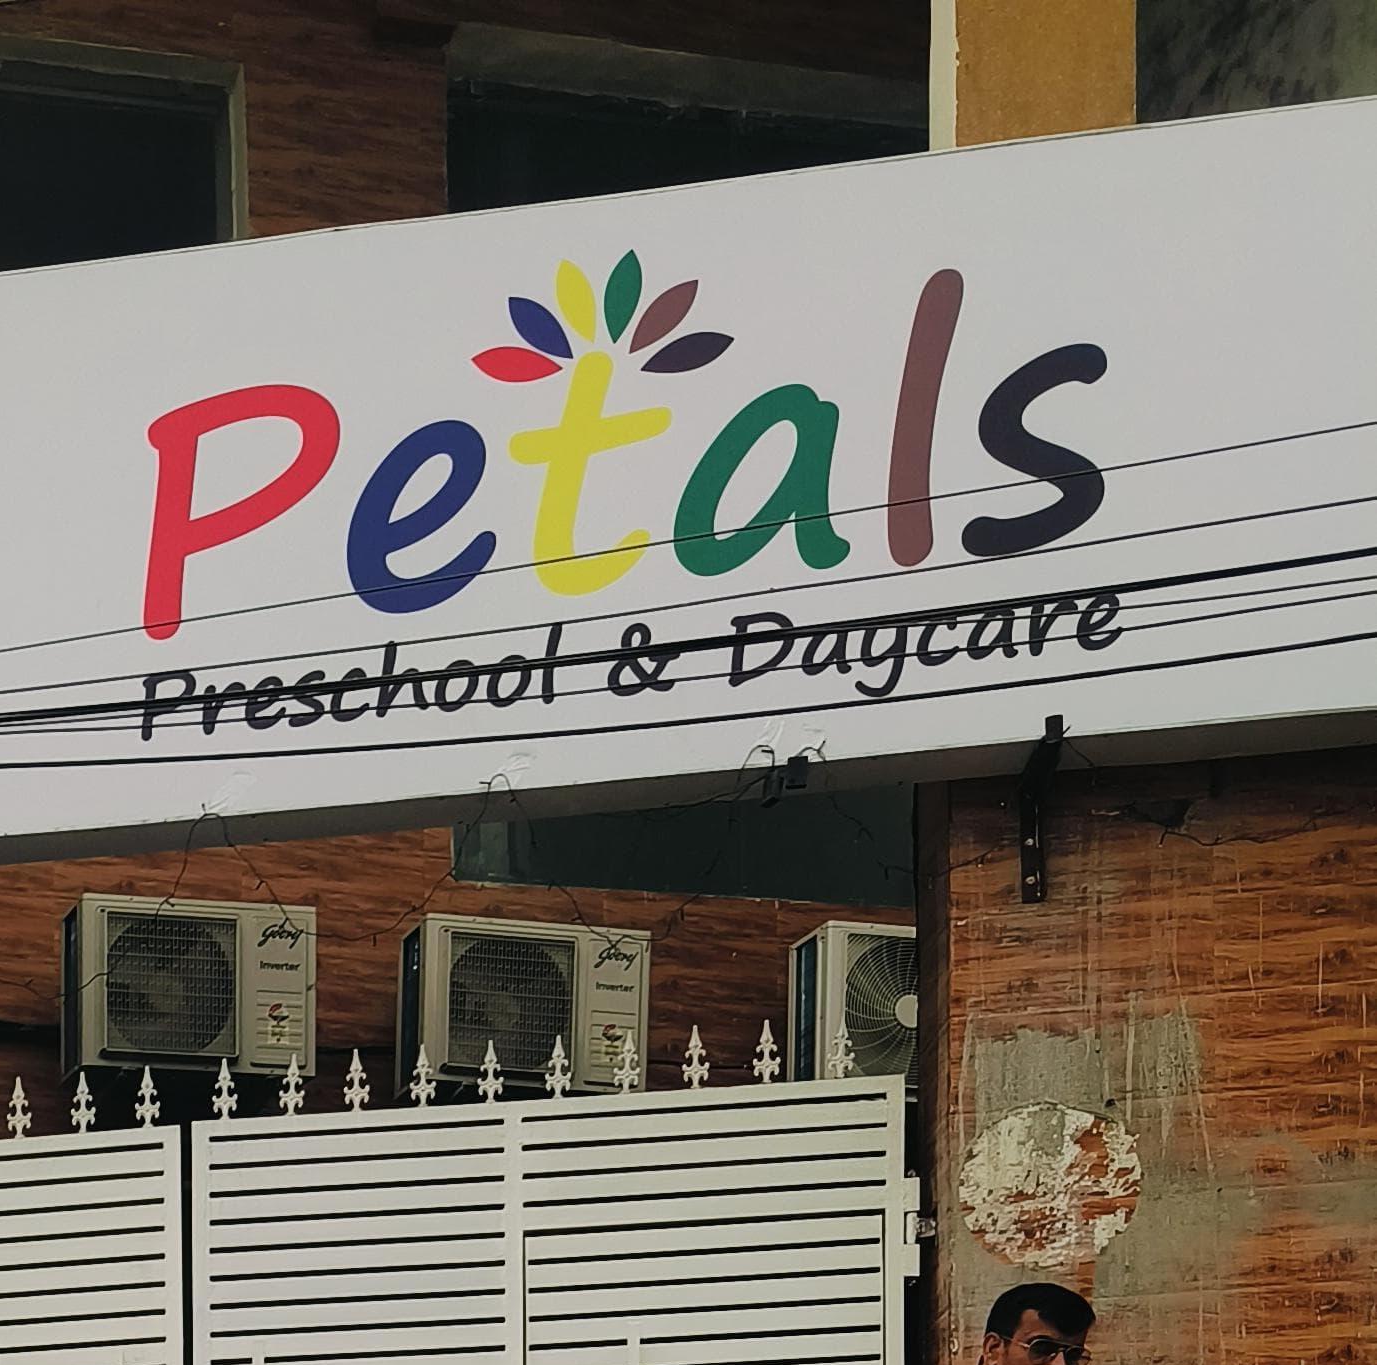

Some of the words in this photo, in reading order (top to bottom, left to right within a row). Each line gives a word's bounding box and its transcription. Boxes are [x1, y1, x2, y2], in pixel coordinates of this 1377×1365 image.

[143, 269, 1108, 641] Petals
[141, 622, 563, 741] Preschool
[607, 622, 680, 696] &
[729, 592, 1123, 698] Daycare
[259, 960, 301, 971] Inverter
